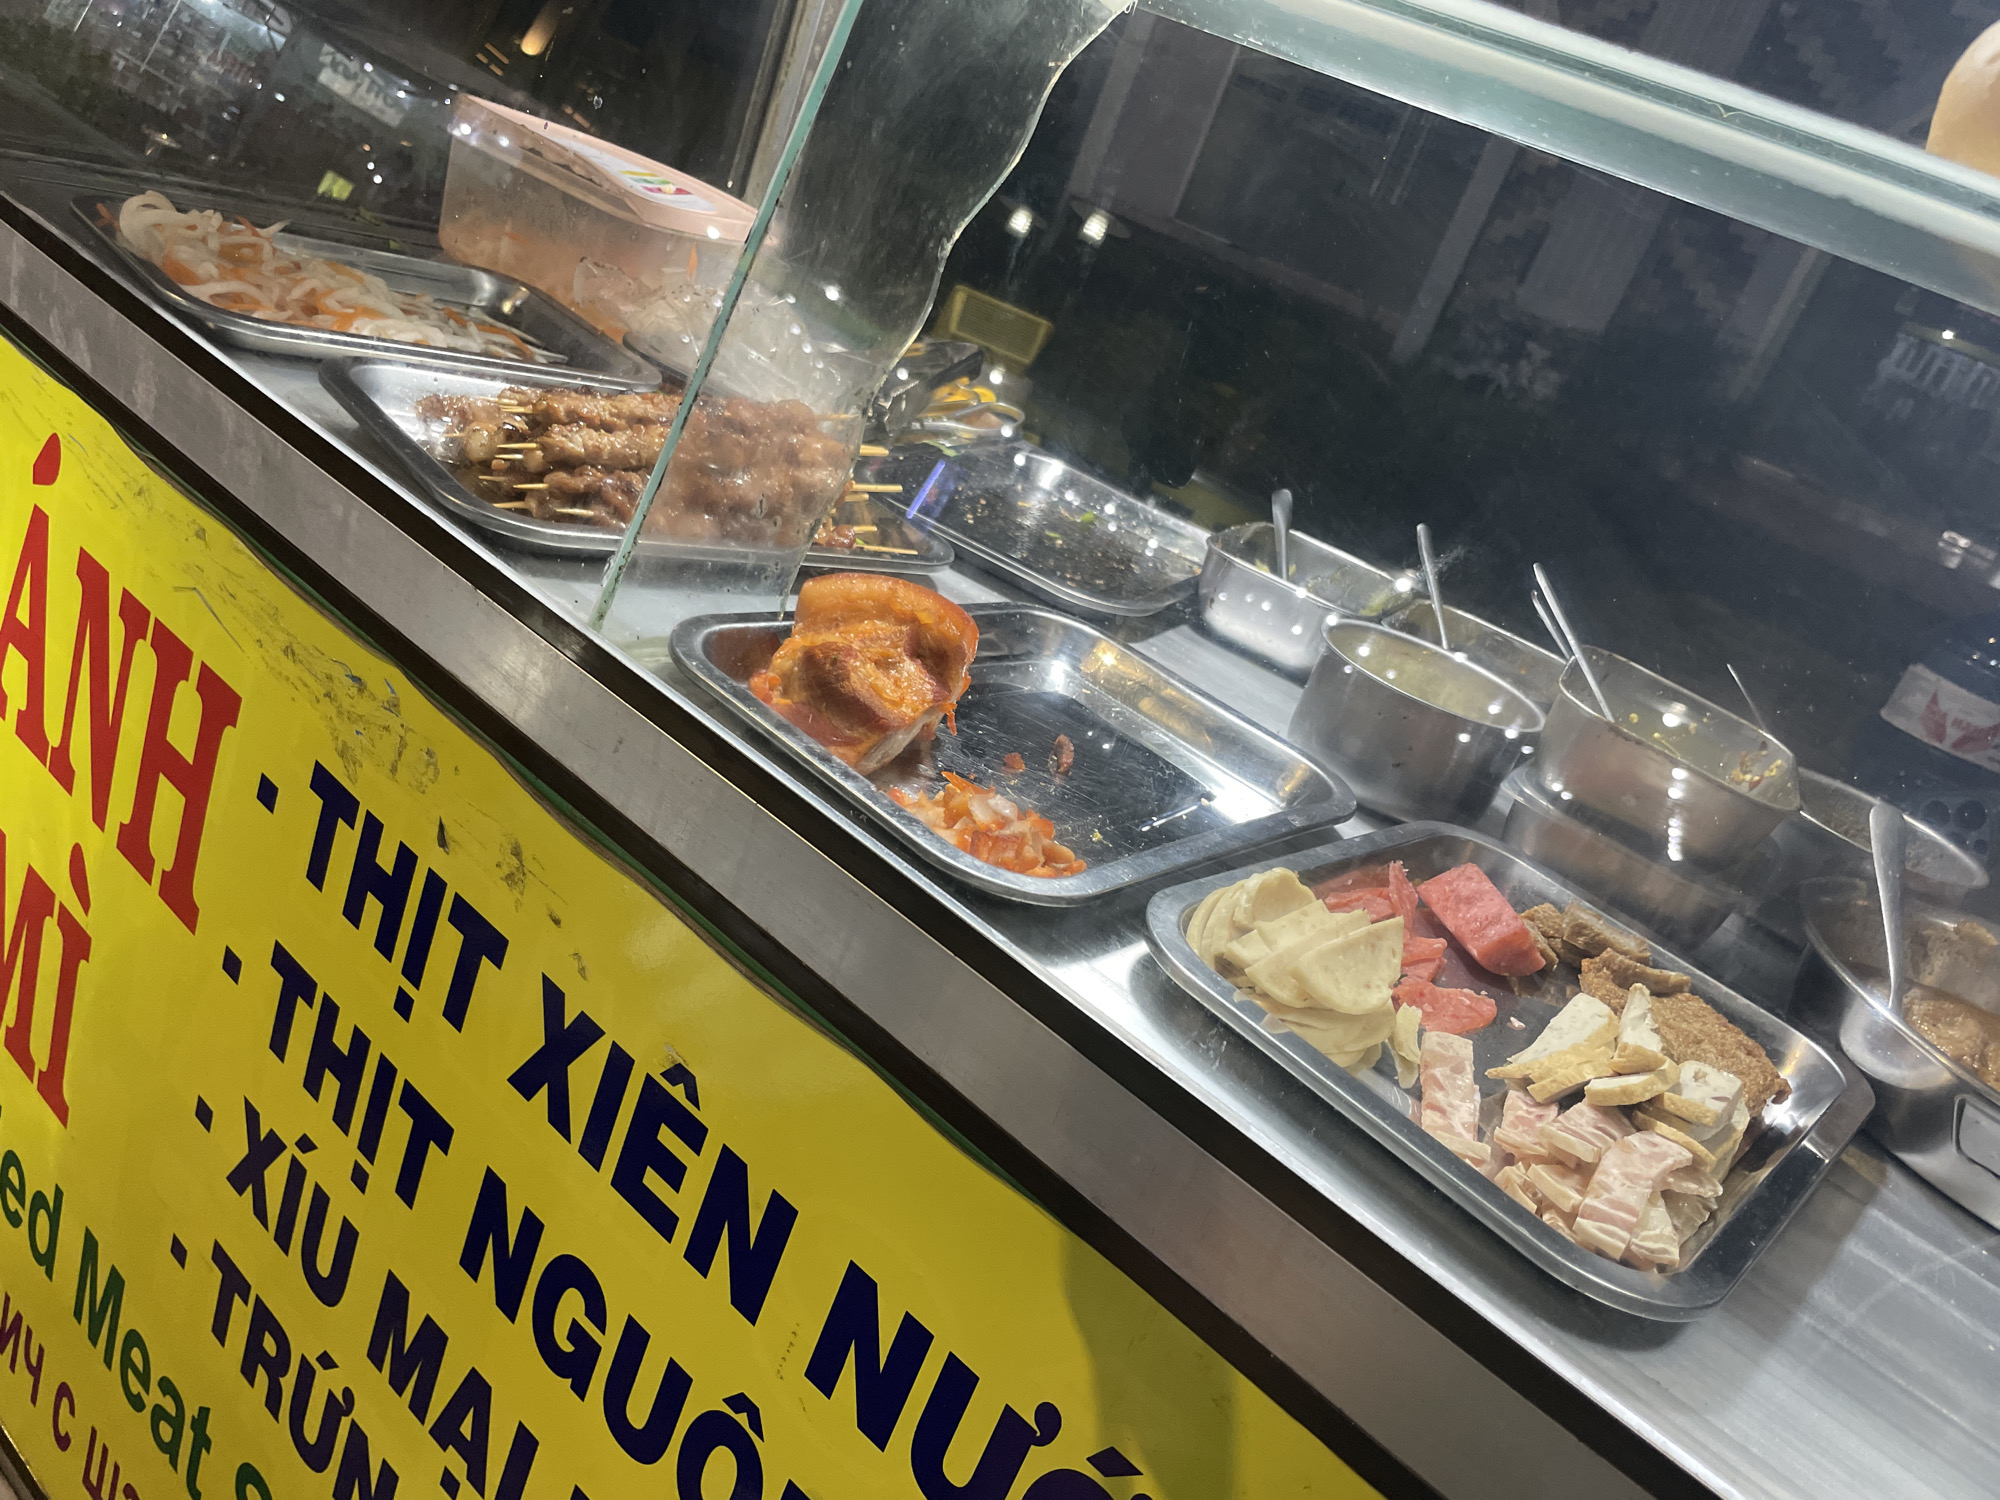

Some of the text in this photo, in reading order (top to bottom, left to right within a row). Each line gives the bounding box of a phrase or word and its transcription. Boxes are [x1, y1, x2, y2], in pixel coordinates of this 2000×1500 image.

[226, 1095, 360, 1308] XÍU
[269, 939, 455, 1211] THỊT
[306, 760, 1152, 1500] THỊT XIÊN NƯ
[0, 1104, 213, 1500] ed Meat
